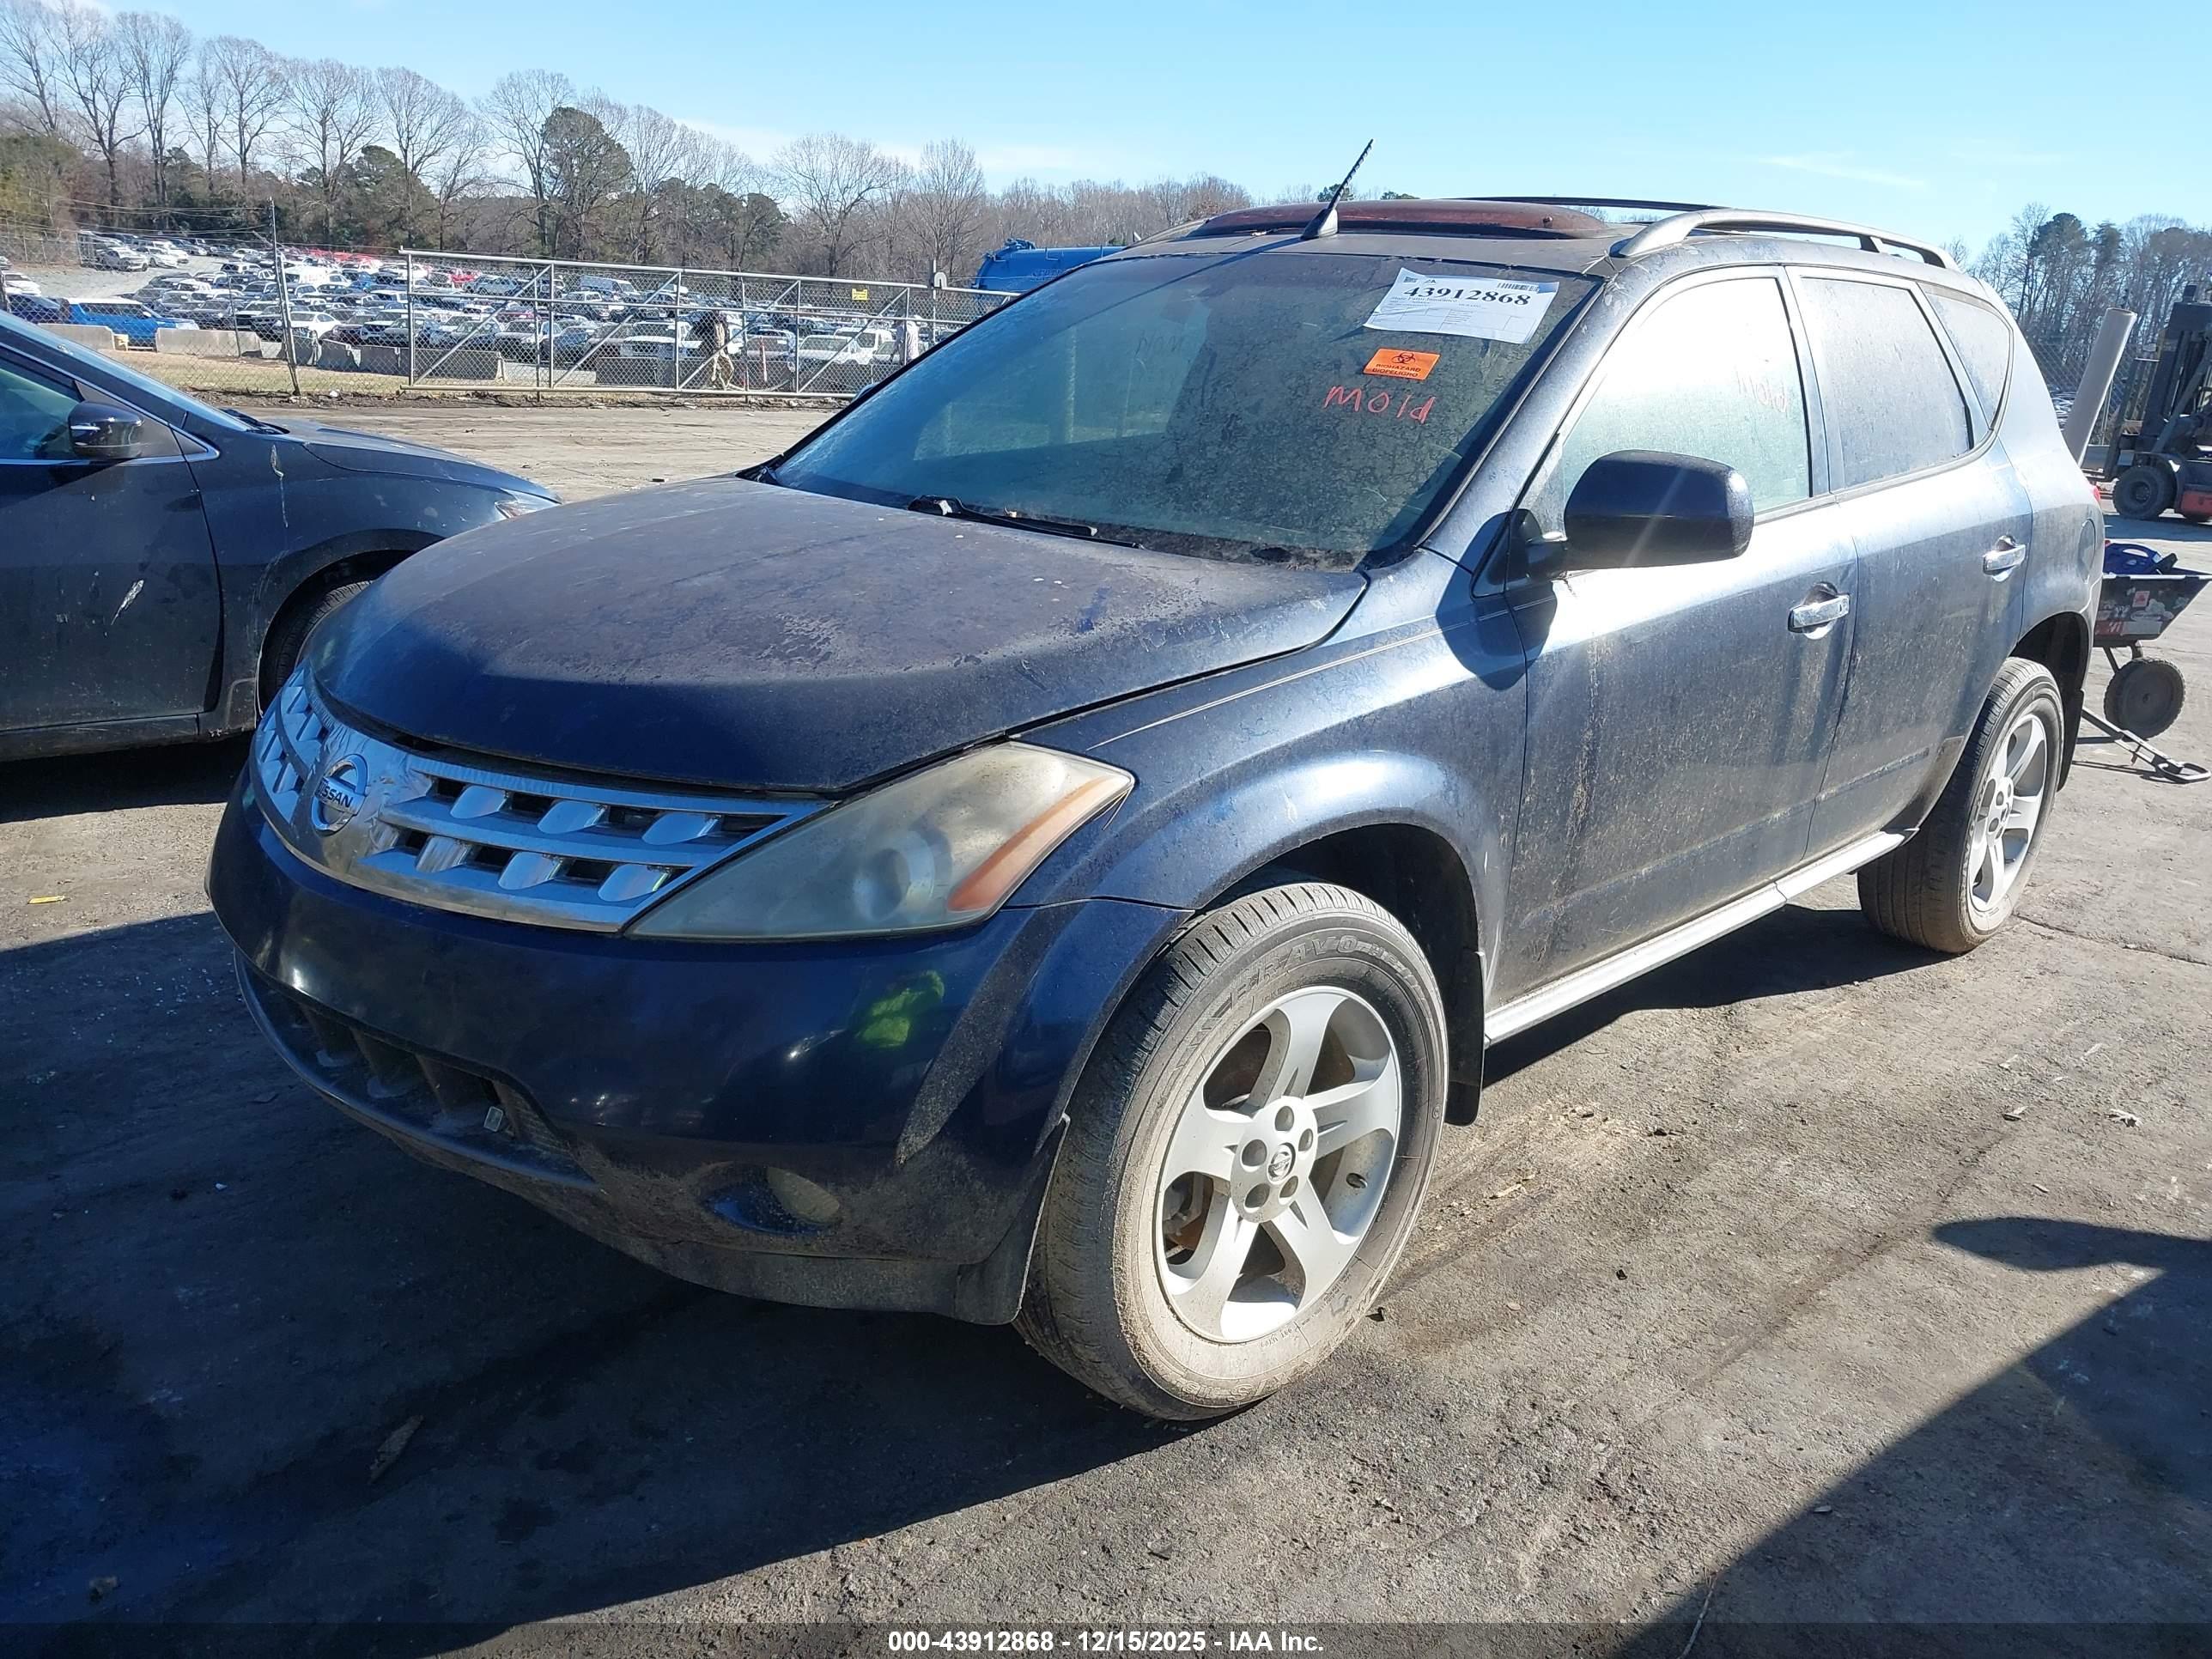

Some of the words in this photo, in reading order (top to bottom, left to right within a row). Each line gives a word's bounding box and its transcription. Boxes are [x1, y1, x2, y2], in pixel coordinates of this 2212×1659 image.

[1403, 286, 1532, 307] 43912868
[1372, 368, 1419, 378] BIOPELIGRO
[1376, 363, 1421, 373] BIOHAZARD
[314, 776, 354, 808] SSAN
